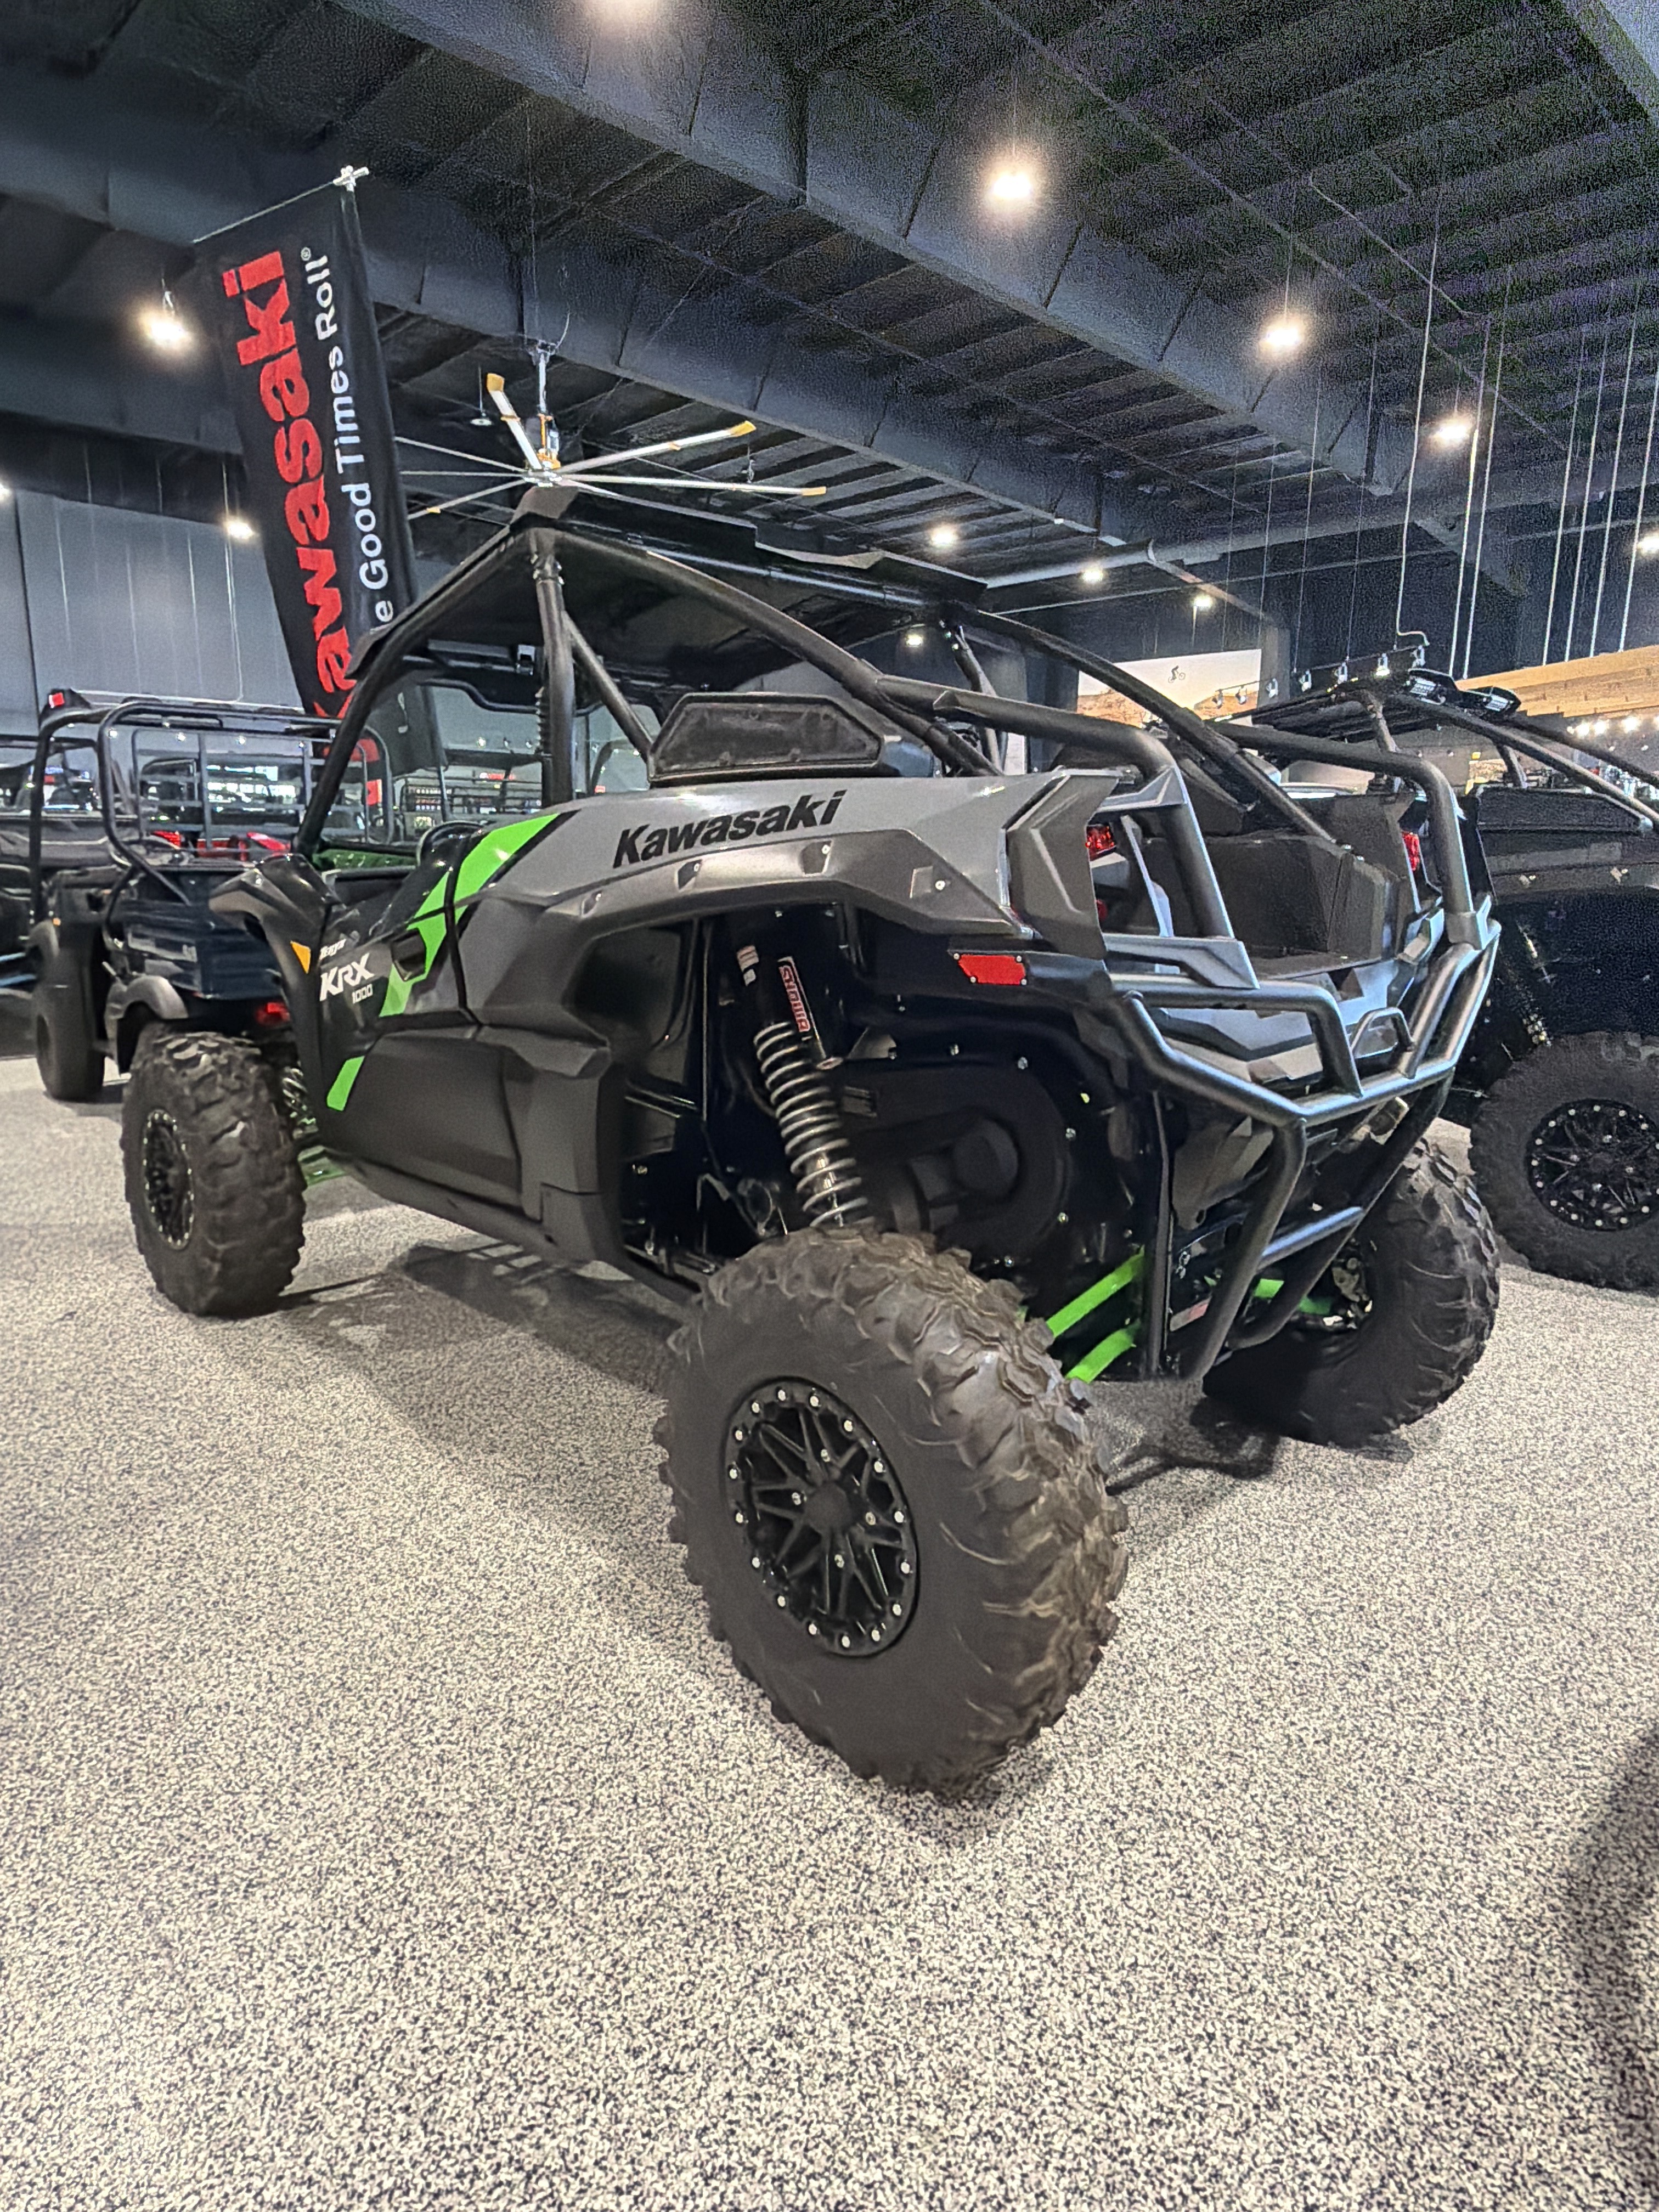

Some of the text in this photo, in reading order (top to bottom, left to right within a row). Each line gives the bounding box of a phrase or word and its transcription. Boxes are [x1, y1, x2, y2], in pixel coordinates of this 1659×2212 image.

[329, 346, 365, 474] Times
[341, 483, 388, 591] Good
[612, 789, 847, 868] Kawasaki
[320, 953, 375, 1001] KRX
[352, 984, 373, 1003] 1000
